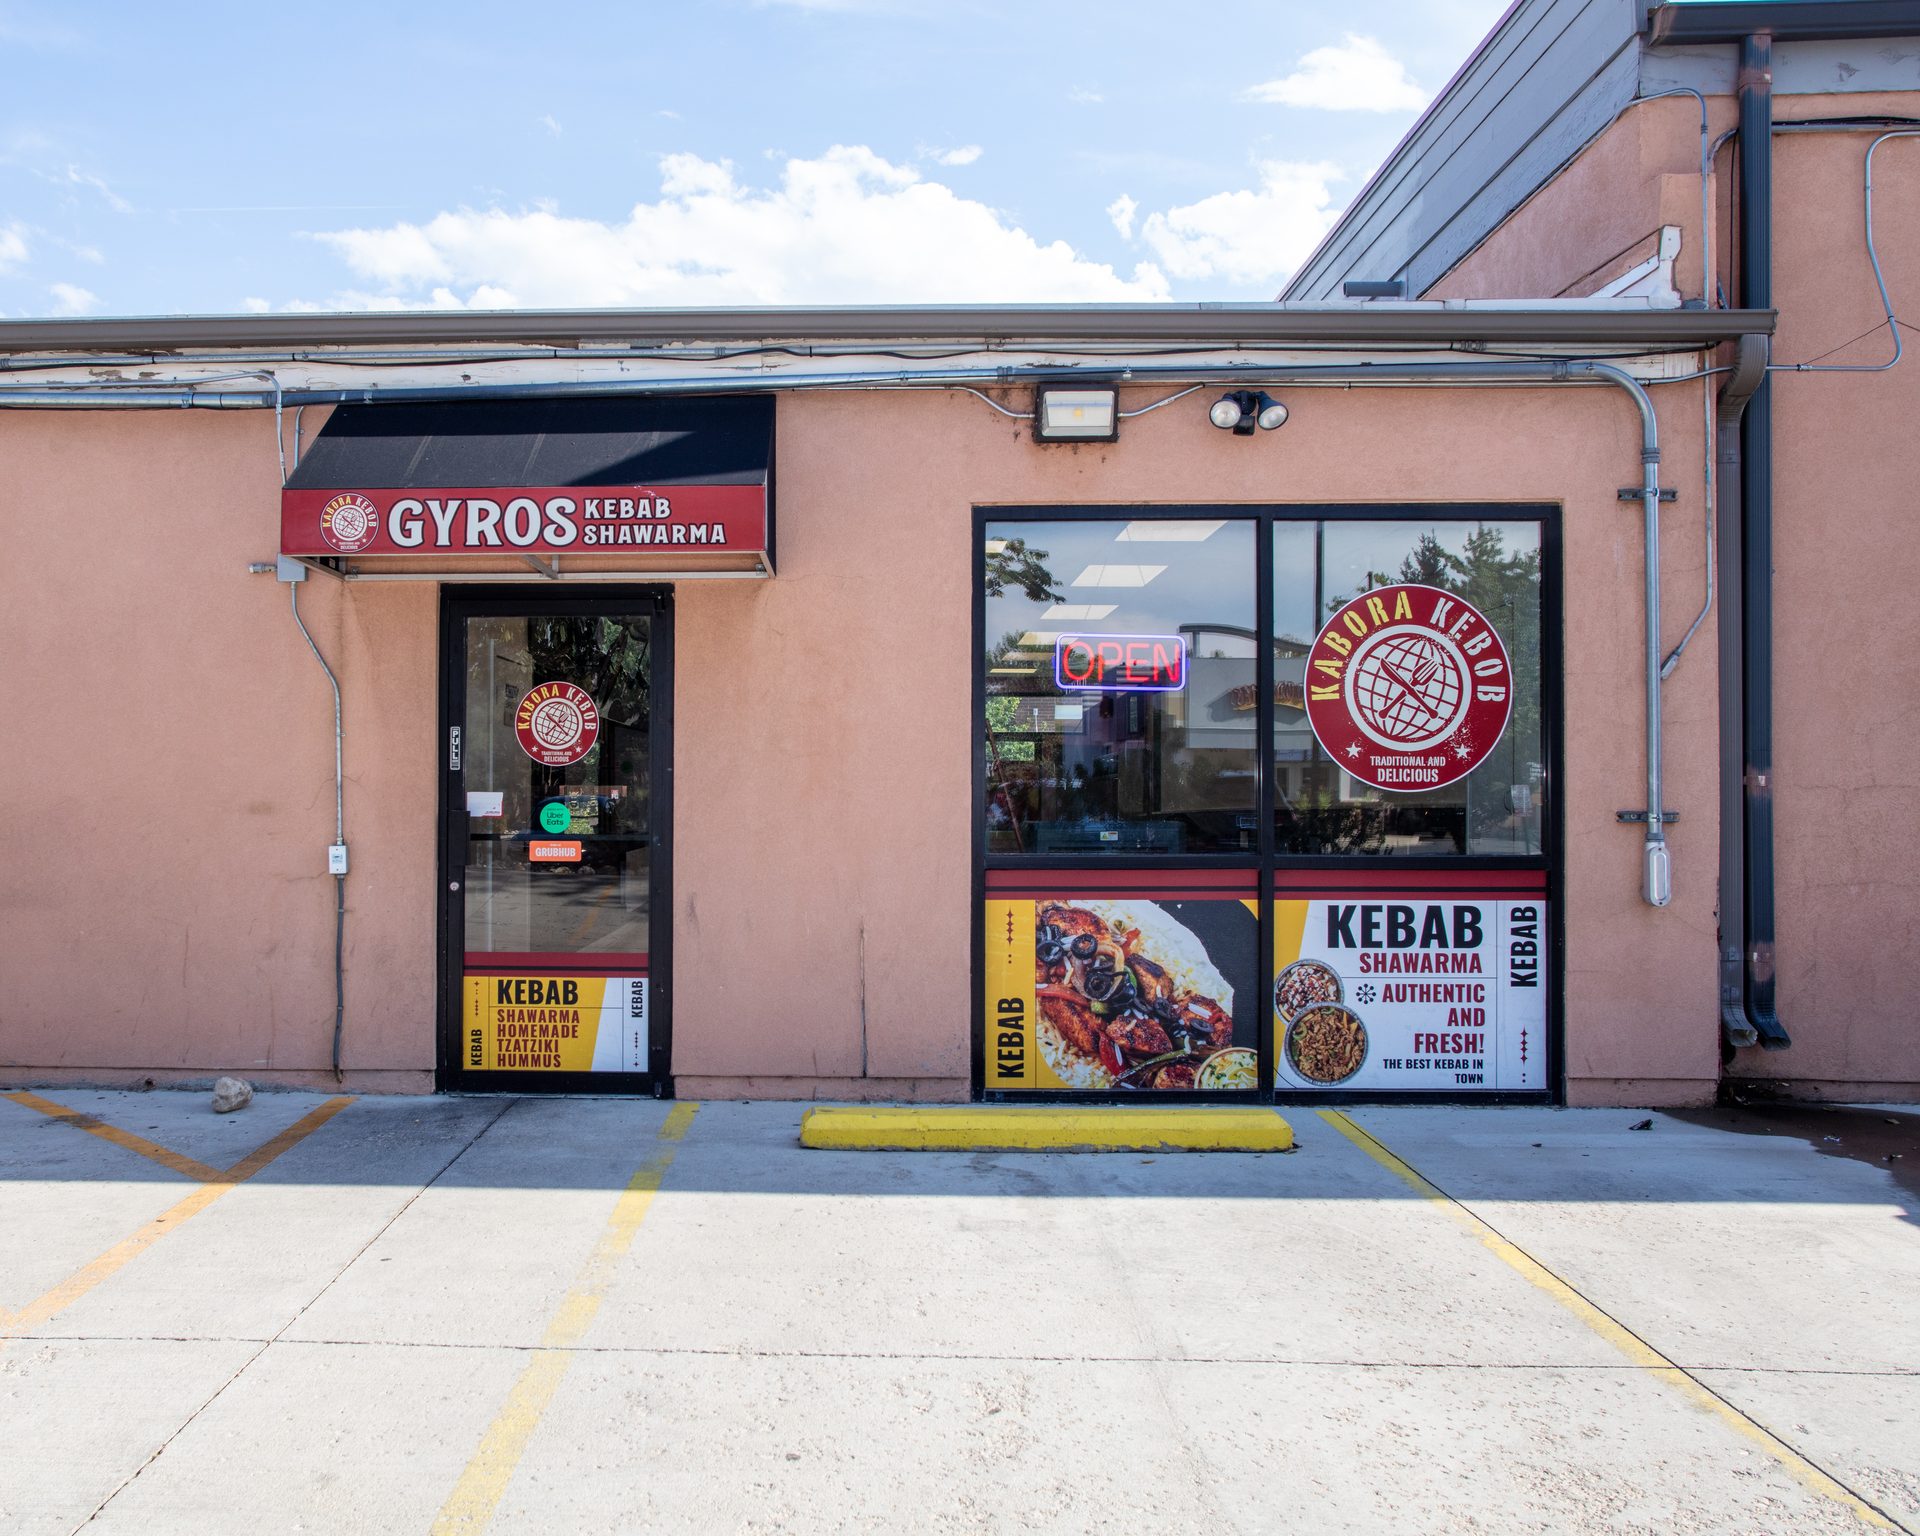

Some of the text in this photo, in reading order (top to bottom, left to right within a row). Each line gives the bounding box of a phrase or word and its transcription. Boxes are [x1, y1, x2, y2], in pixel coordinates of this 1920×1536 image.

[322, 495, 377, 527] KABORA KEBOB
[585, 498, 671, 519] KEBAB
[388, 498, 577, 547] GYROS
[584, 524, 727, 545] SHAWARMA
[1311, 591, 1506, 702] KABORA KEBOB
[1062, 641, 1181, 683] OPEN
[517, 684, 597, 730] KABORA KEBOB
[1370, 755, 1446, 767] TRADITIONAL AND
[1377, 768, 1439, 783] DELICIOUS
[535, 847, 576, 857] GRUBHUB
[1327, 904, 1484, 949] KEBAB
[1510, 906, 1538, 987] KEBAB
[1359, 952, 1483, 974] SHAWARMA
[497, 979, 579, 1005] KEBAB
[631, 980, 643, 1018] KEBAB
[1382, 983, 1486, 1003] AUTHENTIC
[497, 1009, 580, 1024] SHAWARMA
[1447, 1007, 1486, 1027] AND
[497, 1024, 579, 1038] HOMEMADE
[997, 997, 1025, 1078] KEBAB
[471, 1028, 482, 1066] KEBAB
[497, 1039, 559, 1053] TZATZIKI
[1414, 1033, 1485, 1054] FRESH!
[497, 1053, 561, 1068] HUMMUS
[1383, 1058, 1484, 1070] THE BEST KEBAB IN
[1455, 1073, 1484, 1084] TOWN
